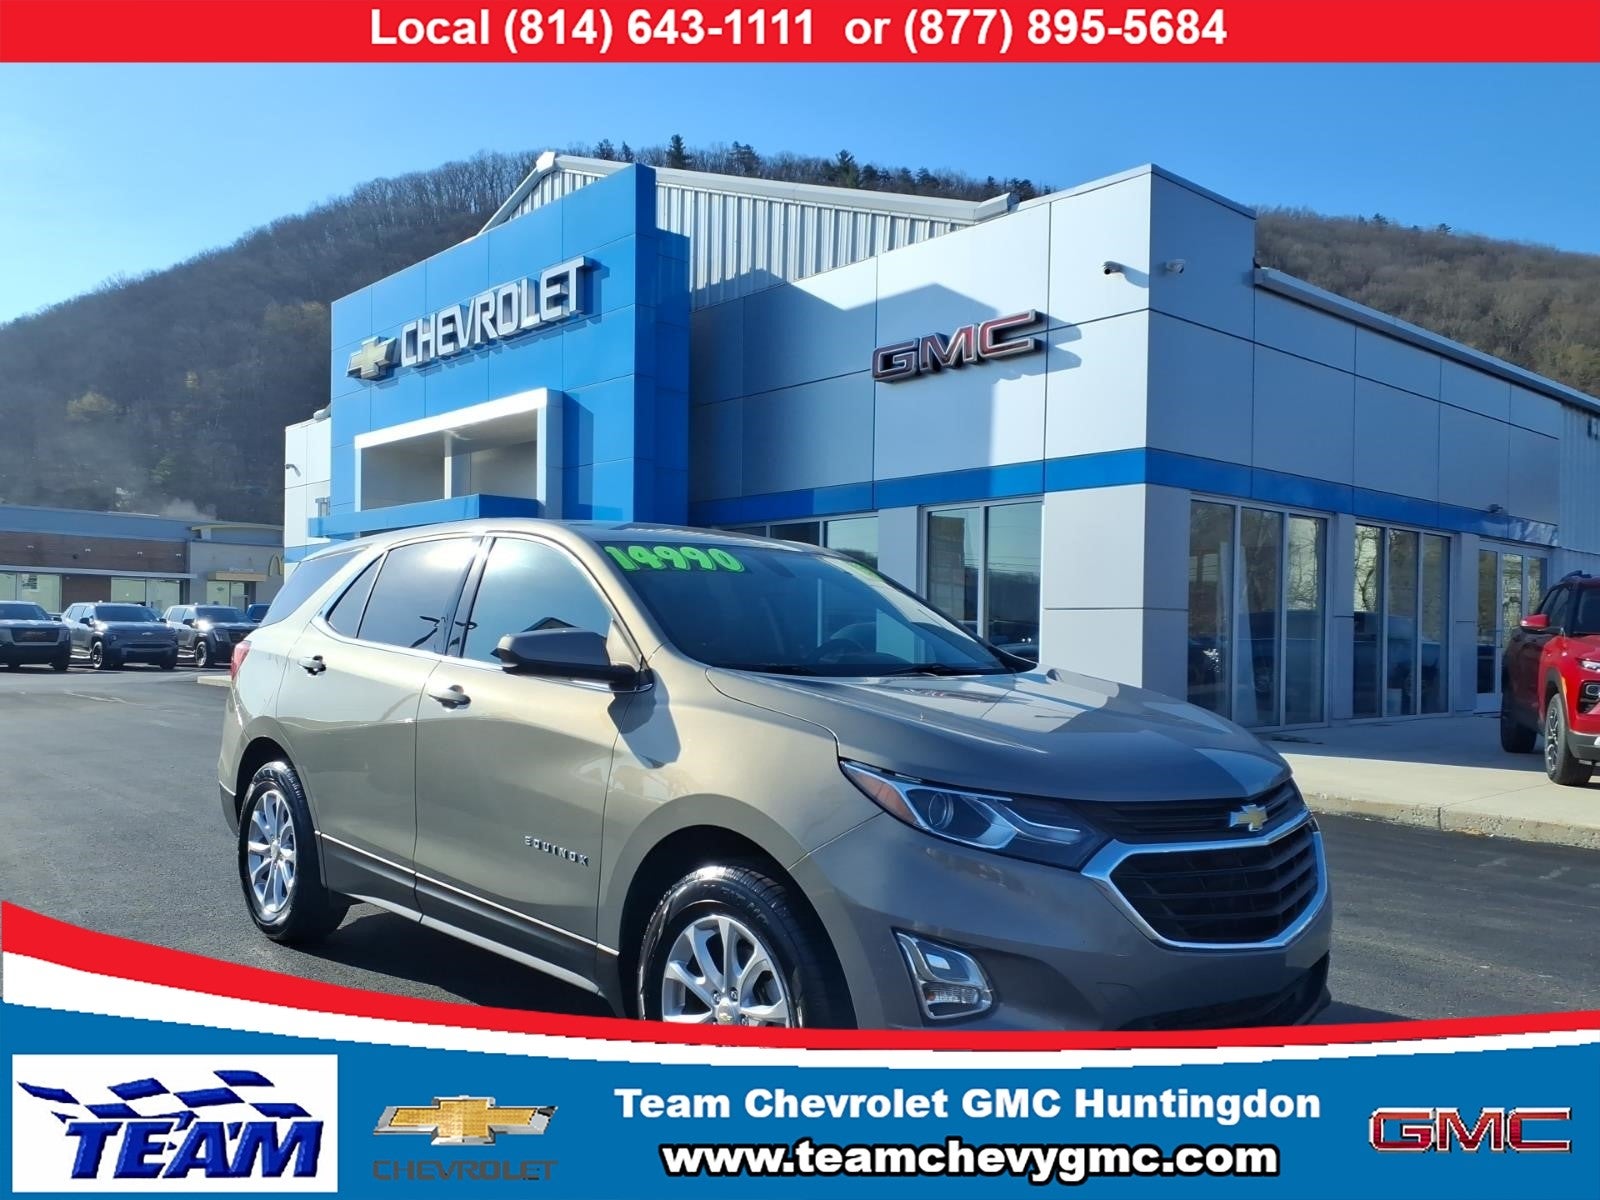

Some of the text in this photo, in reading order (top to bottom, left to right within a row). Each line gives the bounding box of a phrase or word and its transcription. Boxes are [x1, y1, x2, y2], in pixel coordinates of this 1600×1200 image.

[401, 256, 586, 367] CHEVROLET
[871, 309, 1042, 384] GMC
[604, 545, 745, 573] 14990
[524, 835, 589, 866] EQUINOX
